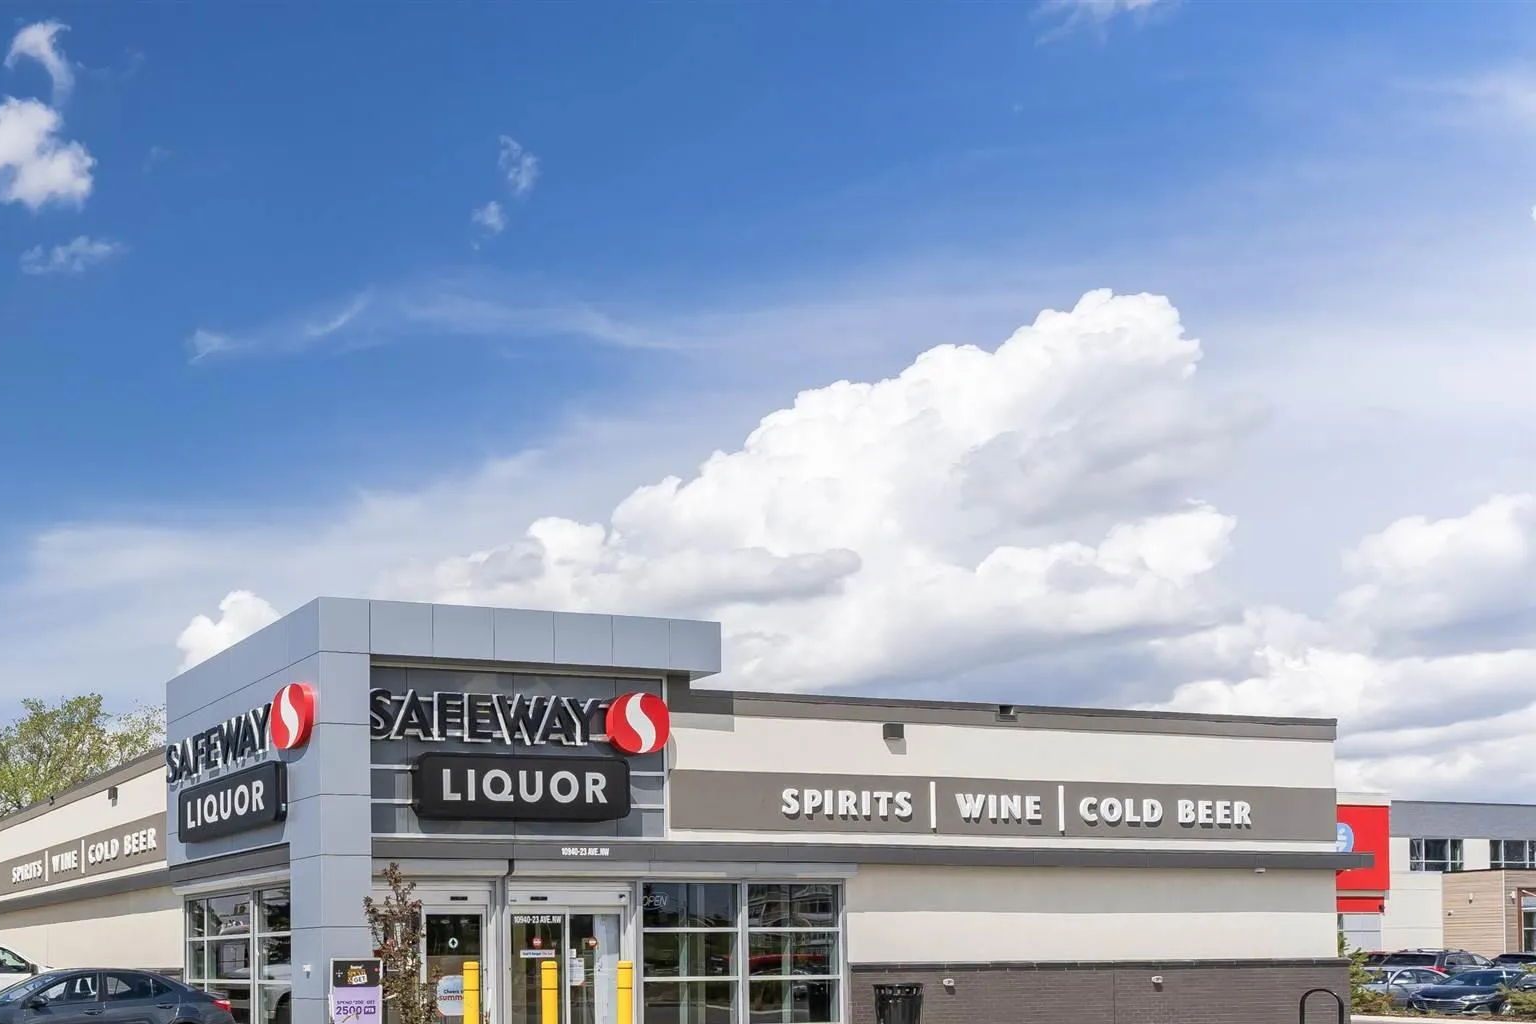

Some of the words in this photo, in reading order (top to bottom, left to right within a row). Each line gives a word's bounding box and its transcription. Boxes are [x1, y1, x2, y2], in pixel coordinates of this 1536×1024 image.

[370, 688, 603, 746] SAFEWAY
[166, 702, 272, 784] SAFEWAY
[187, 780, 265, 829] LIQUOR
[442, 768, 608, 804] LIQUOR
[781, 788, 913, 821] SPIRITS
[955, 793, 1043, 822] WINE
[1079, 797, 1163, 825] COLD
[1177, 799, 1252, 827] BEER
[12, 860, 43, 883] SPIRITS
[51, 850, 78, 873] WINE
[88, 838, 120, 865] COLD
[123, 828, 157, 856] BEER
[561, 848, 587, 856] 10940-23
[643, 896, 667, 906] OPEN
[336, 1006, 362, 1015] 2500
